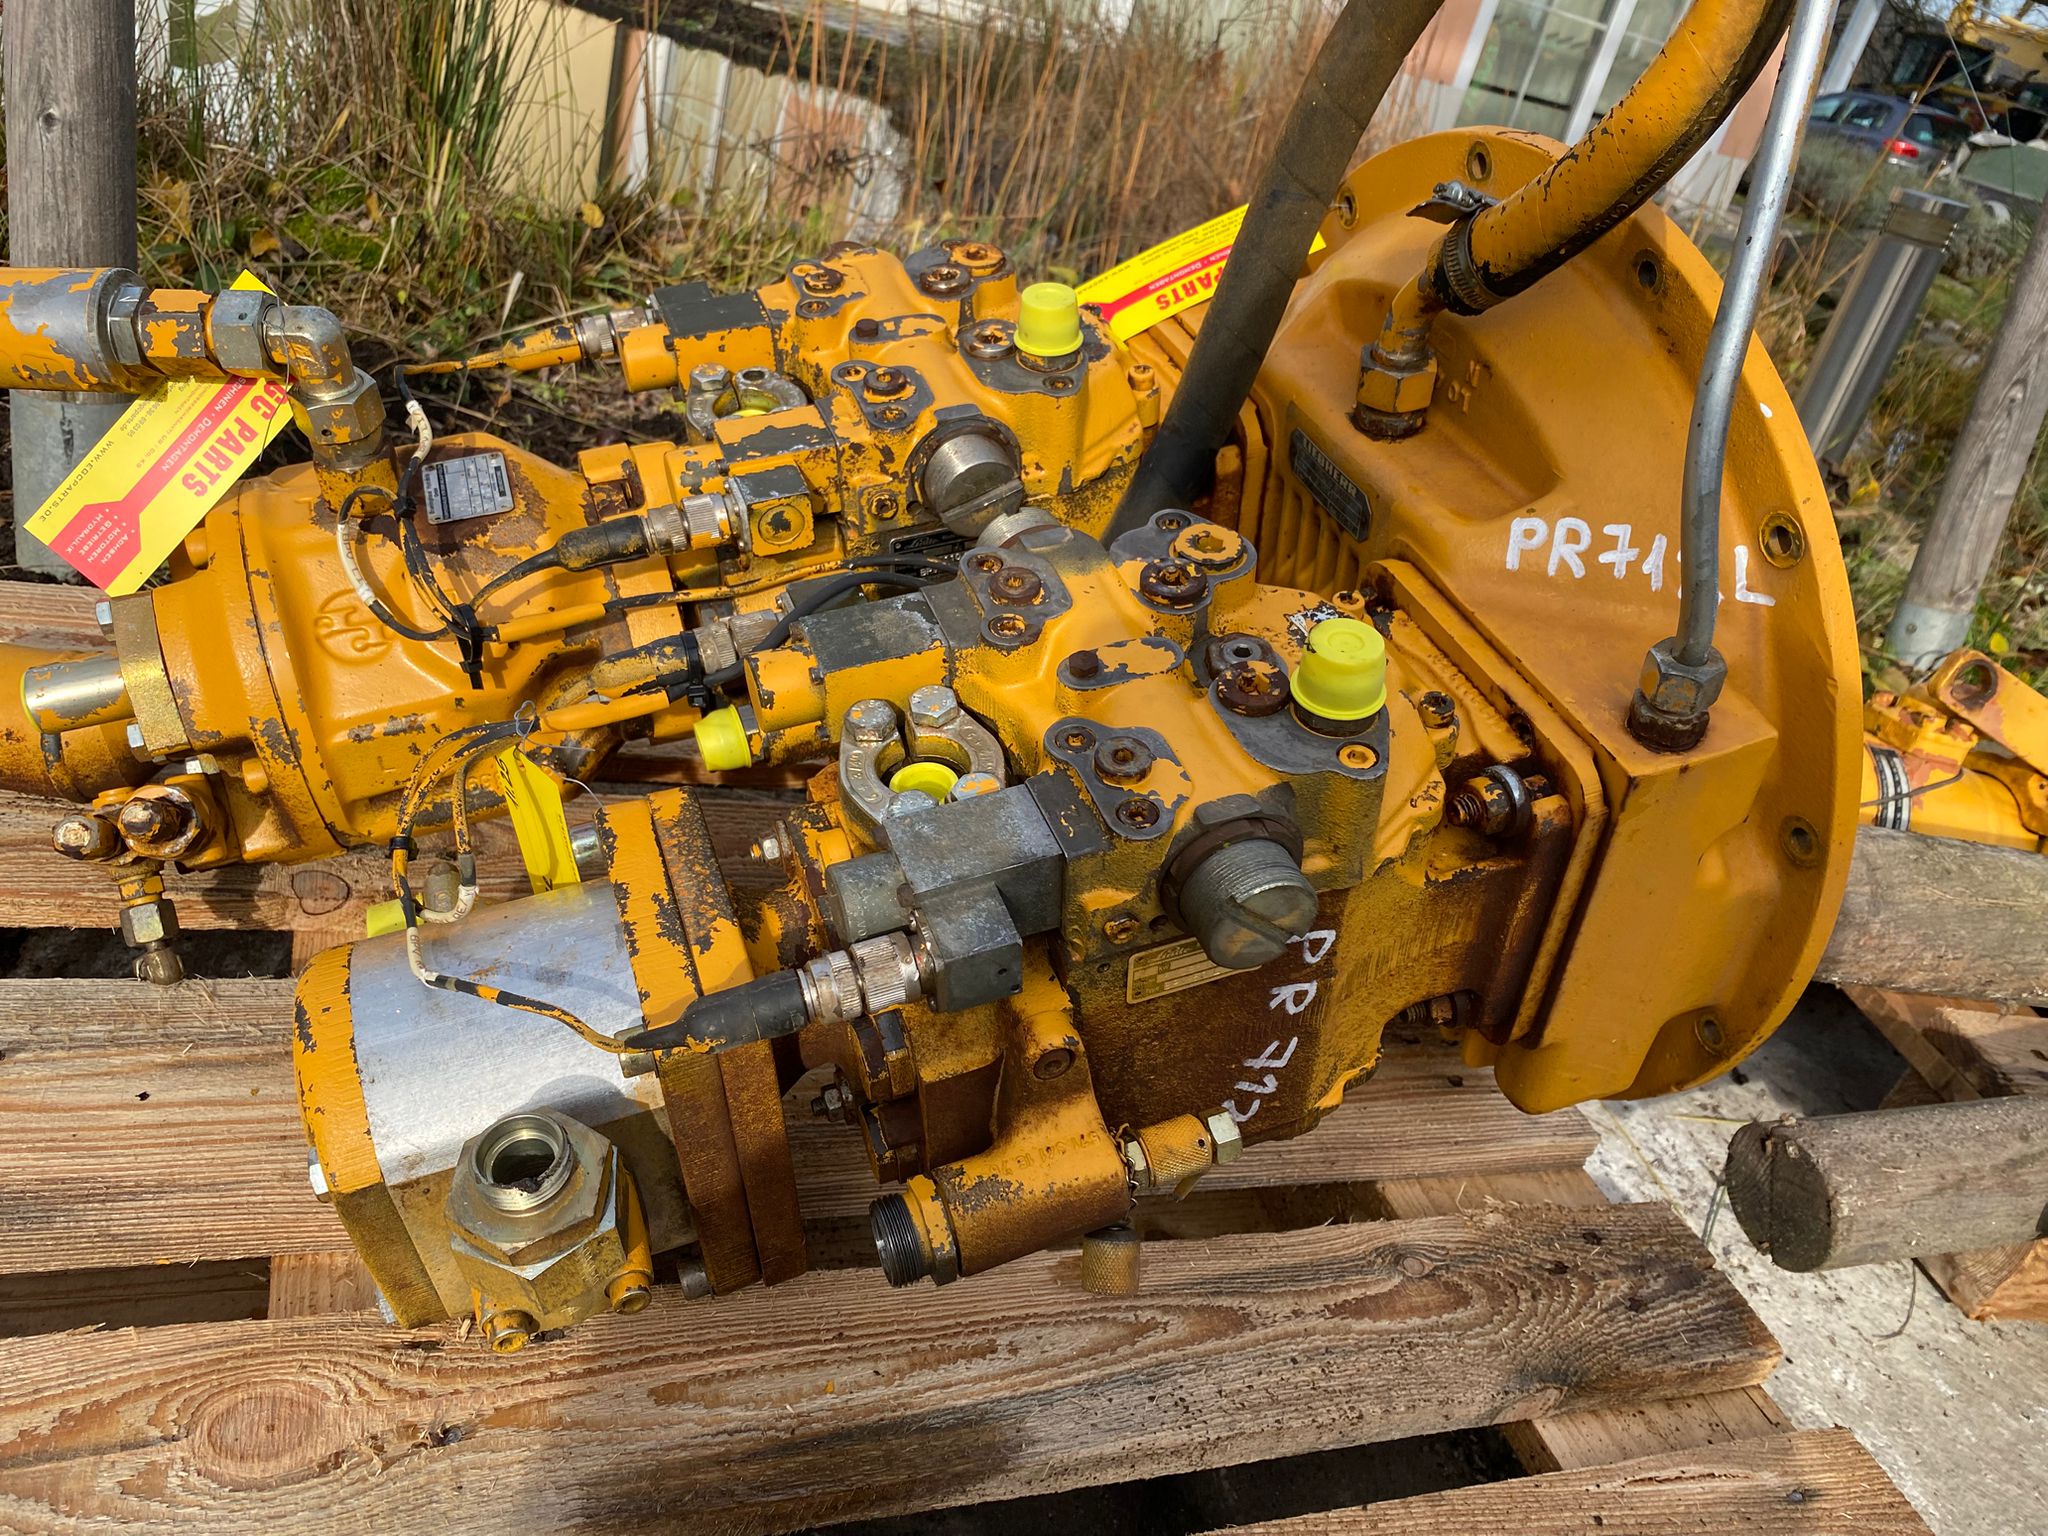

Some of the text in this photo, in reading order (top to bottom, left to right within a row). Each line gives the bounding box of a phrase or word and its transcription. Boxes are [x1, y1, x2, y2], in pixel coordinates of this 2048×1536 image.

[159, 415, 212, 472] DEMONTAGEN
[181, 378, 289, 498] GC PARTS
[1302, 437, 1358, 498] LIEBHERR
[63, 512, 104, 555] HYDRAULIK
[77, 519, 112, 556] GETRIEBE
[86, 526, 121, 563] MOTOREN
[99, 532, 130, 565] ACHSEN
